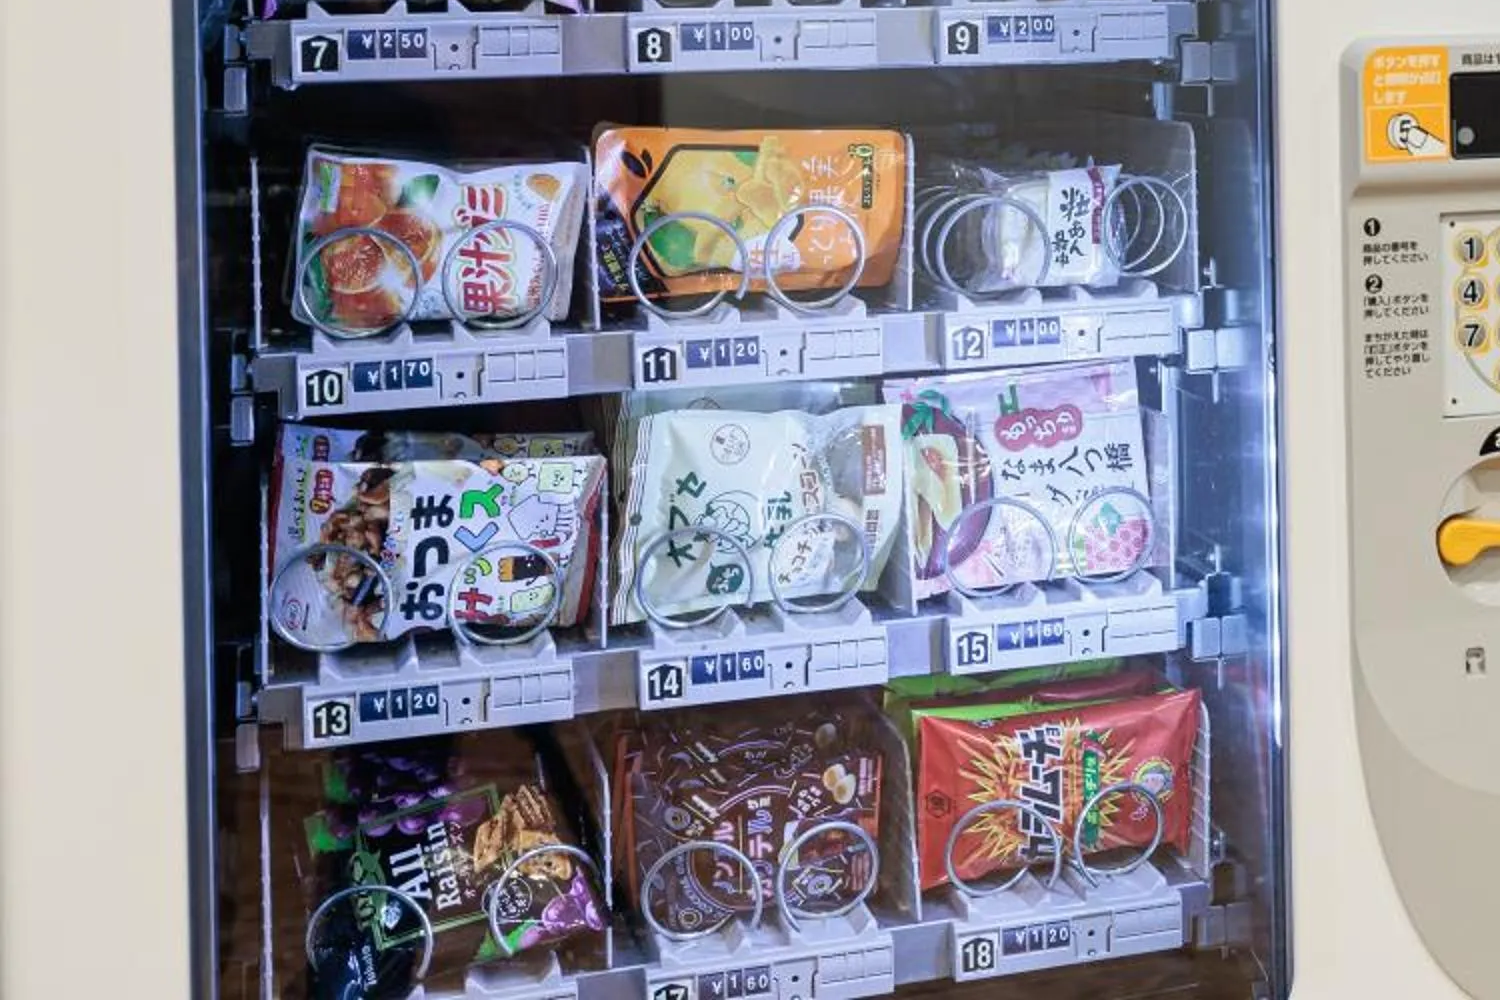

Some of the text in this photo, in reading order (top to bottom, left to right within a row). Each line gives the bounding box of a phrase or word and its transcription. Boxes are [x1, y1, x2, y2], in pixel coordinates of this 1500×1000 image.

[694, 25, 754, 45] ¥100
[999, 17, 1055, 36] ¥200
[361, 32, 426, 50] ¥250
[646, 34, 662, 58] 8
[954, 26, 970, 53] 9
[311, 41, 328, 69] 7
[1464, 238, 1475, 260] 1
[1463, 280, 1478, 303] 4
[1003, 320, 1060, 338] ¥100
[1463, 324, 1479, 348] 7
[700, 342, 760, 362] ¥120
[952, 329, 983, 358] 12
[368, 359, 432, 386] ¥170
[644, 349, 674, 380] 11
[306, 373, 340, 404] 10
[1009, 621, 1064, 646] ¥160
[957, 635, 987, 664] 15
[703, 653, 766, 676] ¥160
[647, 671, 680, 699] 14
[372, 692, 438, 714] ¥120
[315, 705, 348, 736] 13
[389, 821, 462, 911] All Raisin
[1015, 925, 1069, 949] ¥120
[963, 940, 993, 969] 18
[712, 973, 770, 997] ¥160
